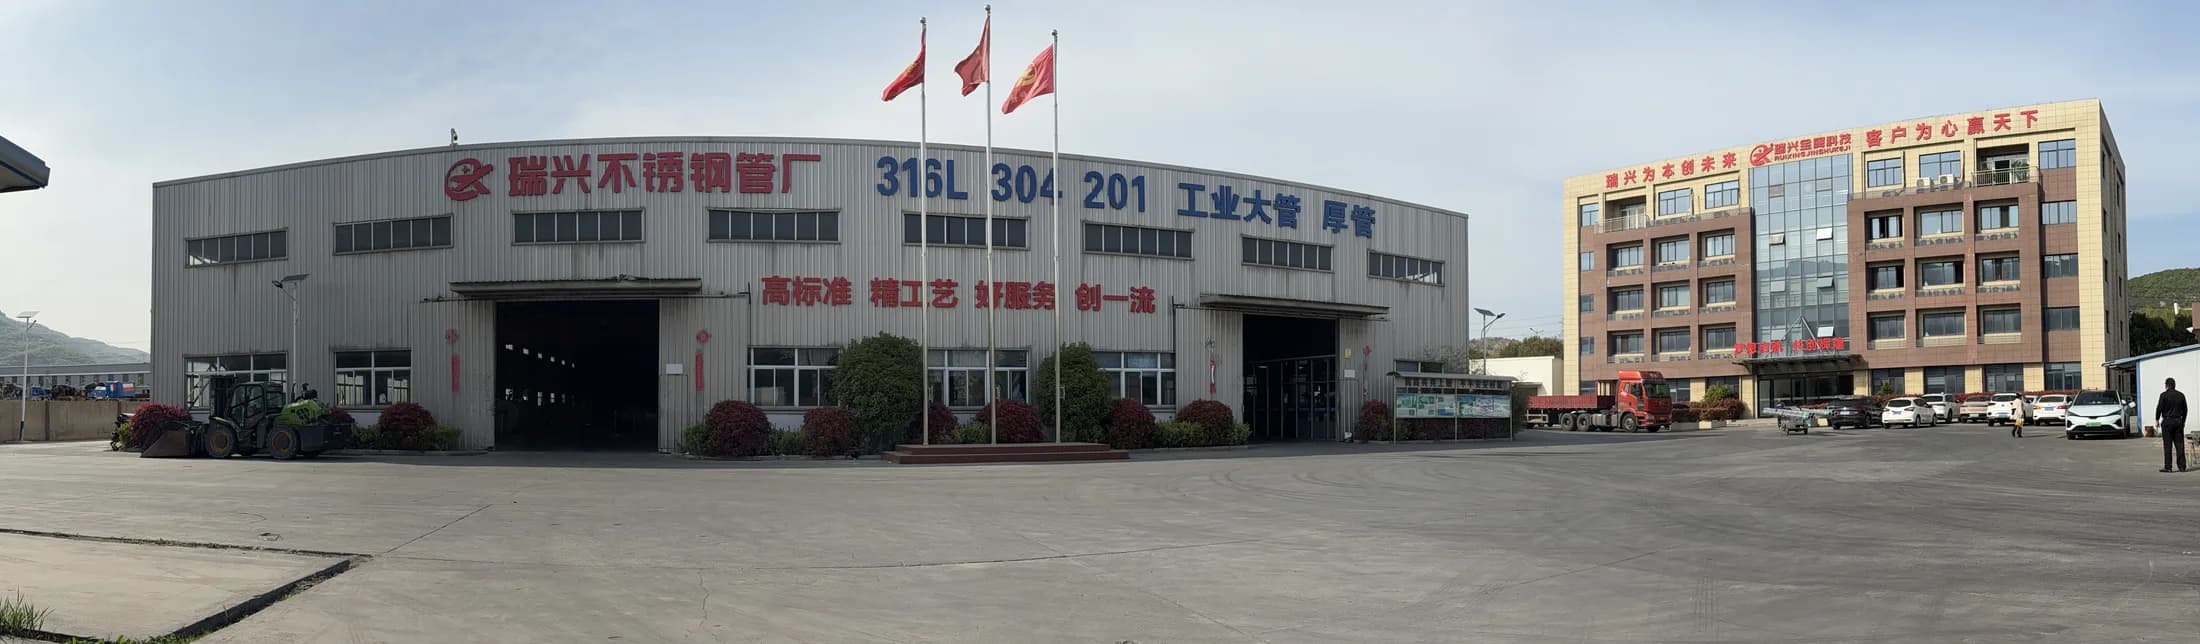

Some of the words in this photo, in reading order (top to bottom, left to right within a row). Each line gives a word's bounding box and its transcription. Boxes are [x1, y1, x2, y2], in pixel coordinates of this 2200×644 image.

[1774, 132, 1852, 155] 瑞兴金属科技
[1866, 109, 2039, 148] 客户为心赢天下
[508, 152, 822, 196] 瑞兴不锈钢管厂
[1605, 151, 1737, 189] 瑞兴为本创未来
[876, 156, 969, 200] 316L
[991, 162, 1063, 205] 304
[1084, 170, 1147, 213] 201
[1177, 181, 1302, 229] 工业大管
[1322, 199, 1376, 238] 厚管
[761, 275, 851, 306] 高标准
[870, 278, 958, 308] 精工艺
[975, 280, 1056, 310] 好服务
[1075, 283, 1155, 313] 创一流
